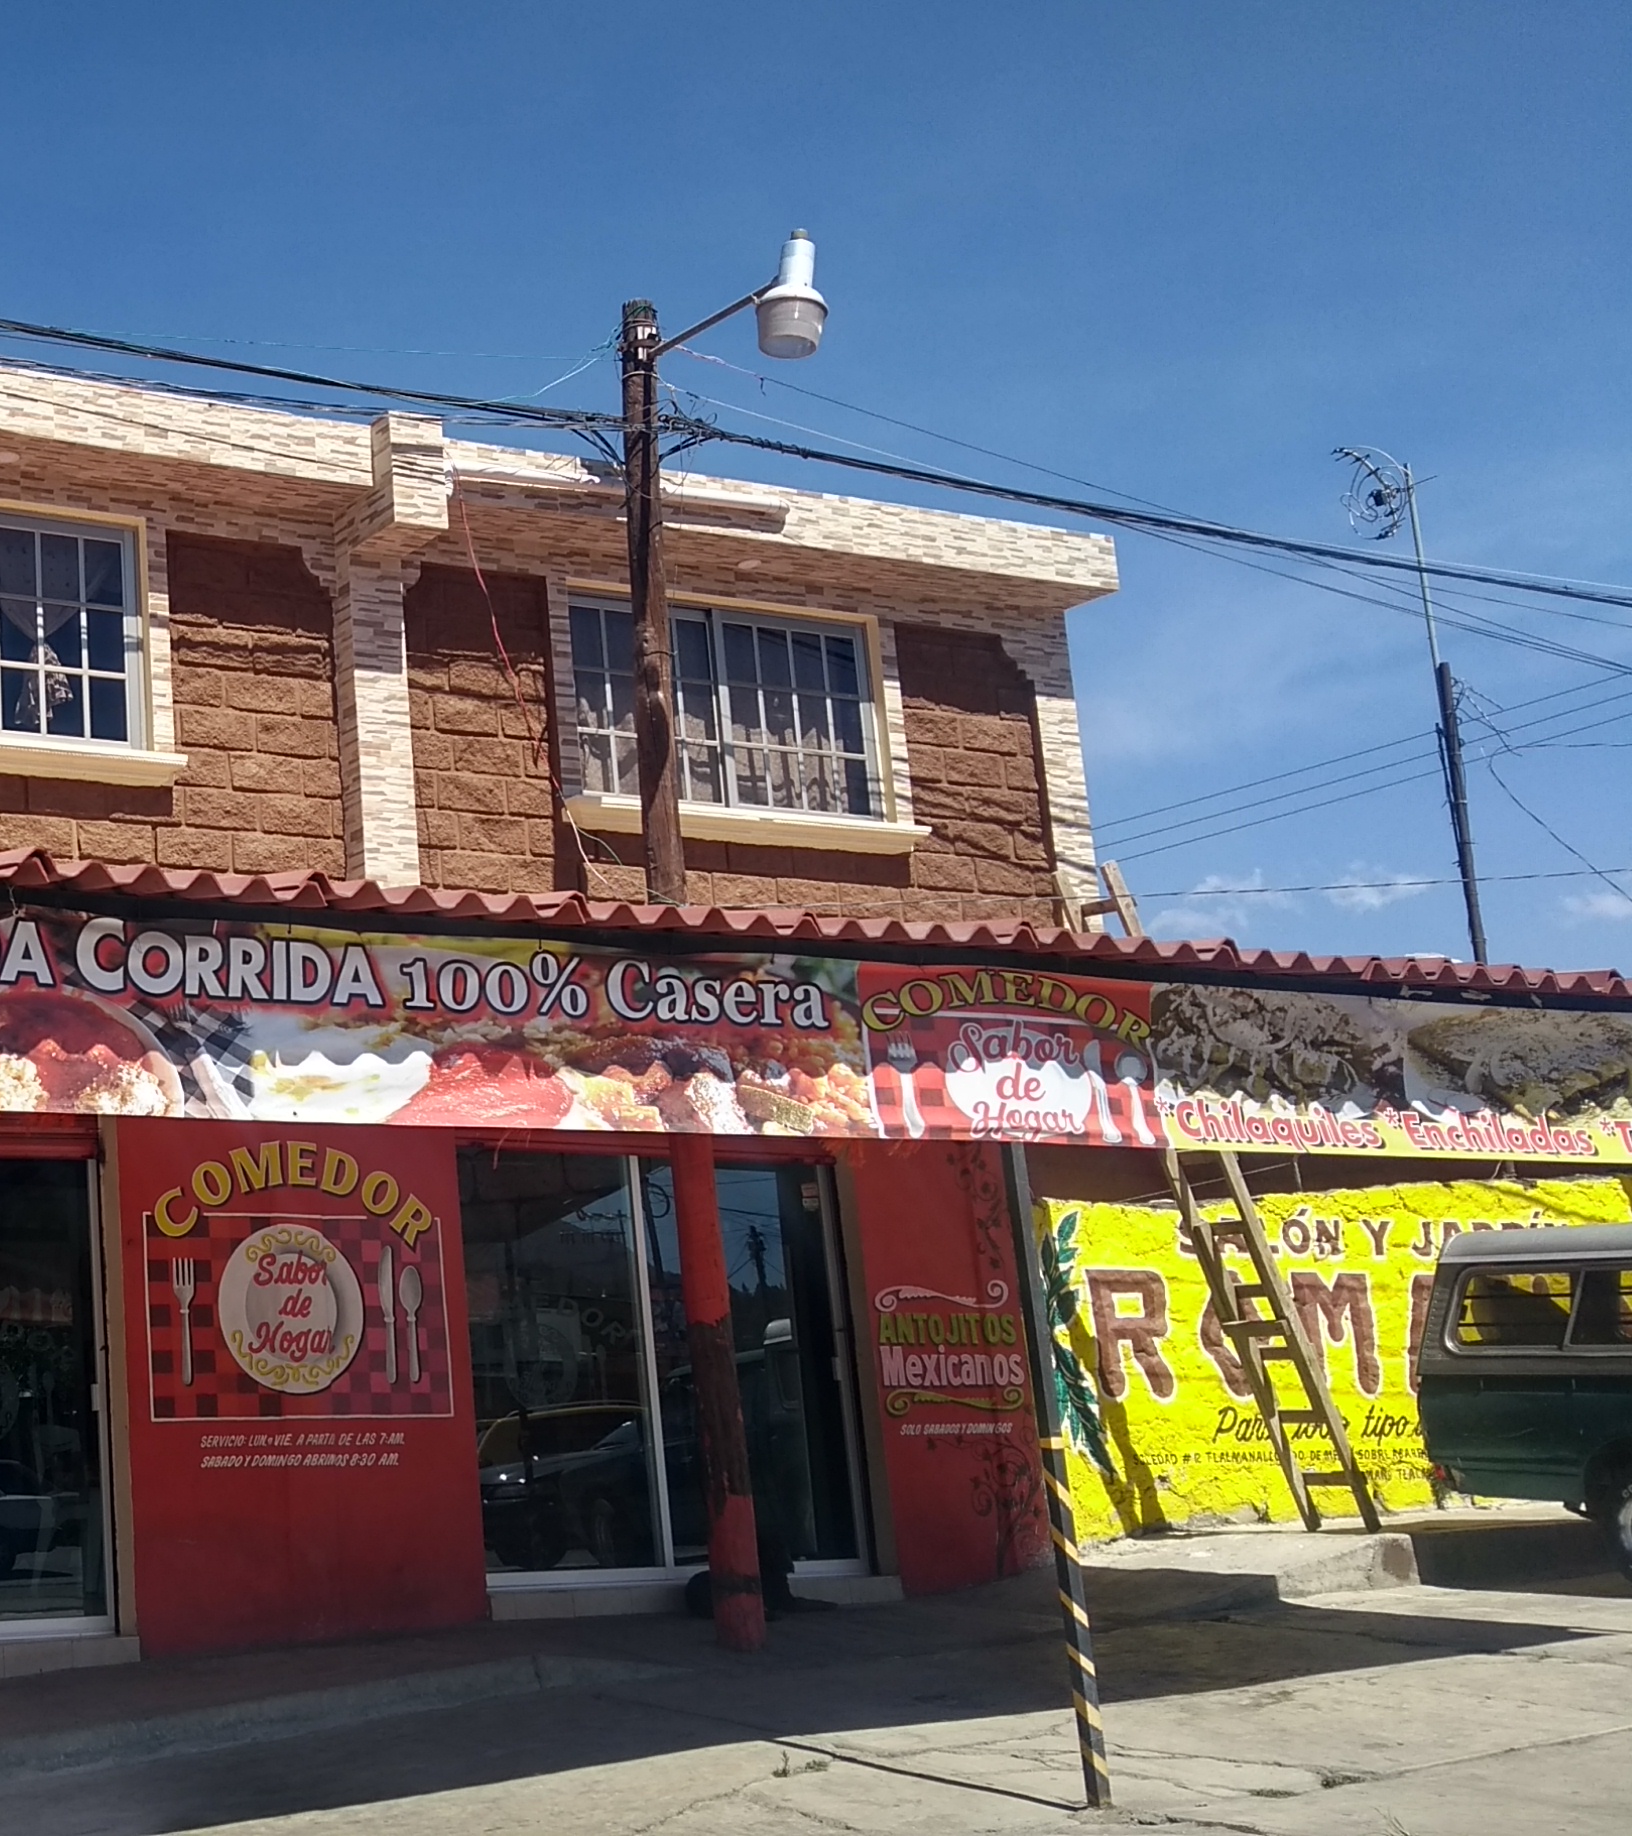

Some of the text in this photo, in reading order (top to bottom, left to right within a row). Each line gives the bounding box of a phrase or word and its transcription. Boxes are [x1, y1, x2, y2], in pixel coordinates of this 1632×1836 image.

[74, 916, 383, 1010] CORRIDA
[401, 946, 589, 1019] 100%
[605, 958, 829, 1030] Casera
[862, 970, 1152, 1047] COMEDOR
[948, 1019, 1080, 1074] Sabor
[996, 1062, 1046, 1101] de
[970, 1101, 1084, 1140] Hogar
[1175, 1100, 1383, 1154] Chilaquiles
[1402, 1108, 1597, 1157] Enchiladas
[154, 1140, 432, 1247] COMEDOR
[1361, 1220, 1390, 1255] Y
[278, 1288, 312, 1318] de
[879, 1313, 1016, 1345] ANTOJITOS
[879, 1345, 1025, 1386] Mexicanos
[338, 1433, 354, 1446] DE
[355, 1433, 376, 1446] LAS
[900, 1423, 921, 1435] SOLO
[1361, 1405, 1409, 1446] tipo
[200, 1455, 243, 1468] SABADO
[251, 1454, 303, 1468] DOMINGO
